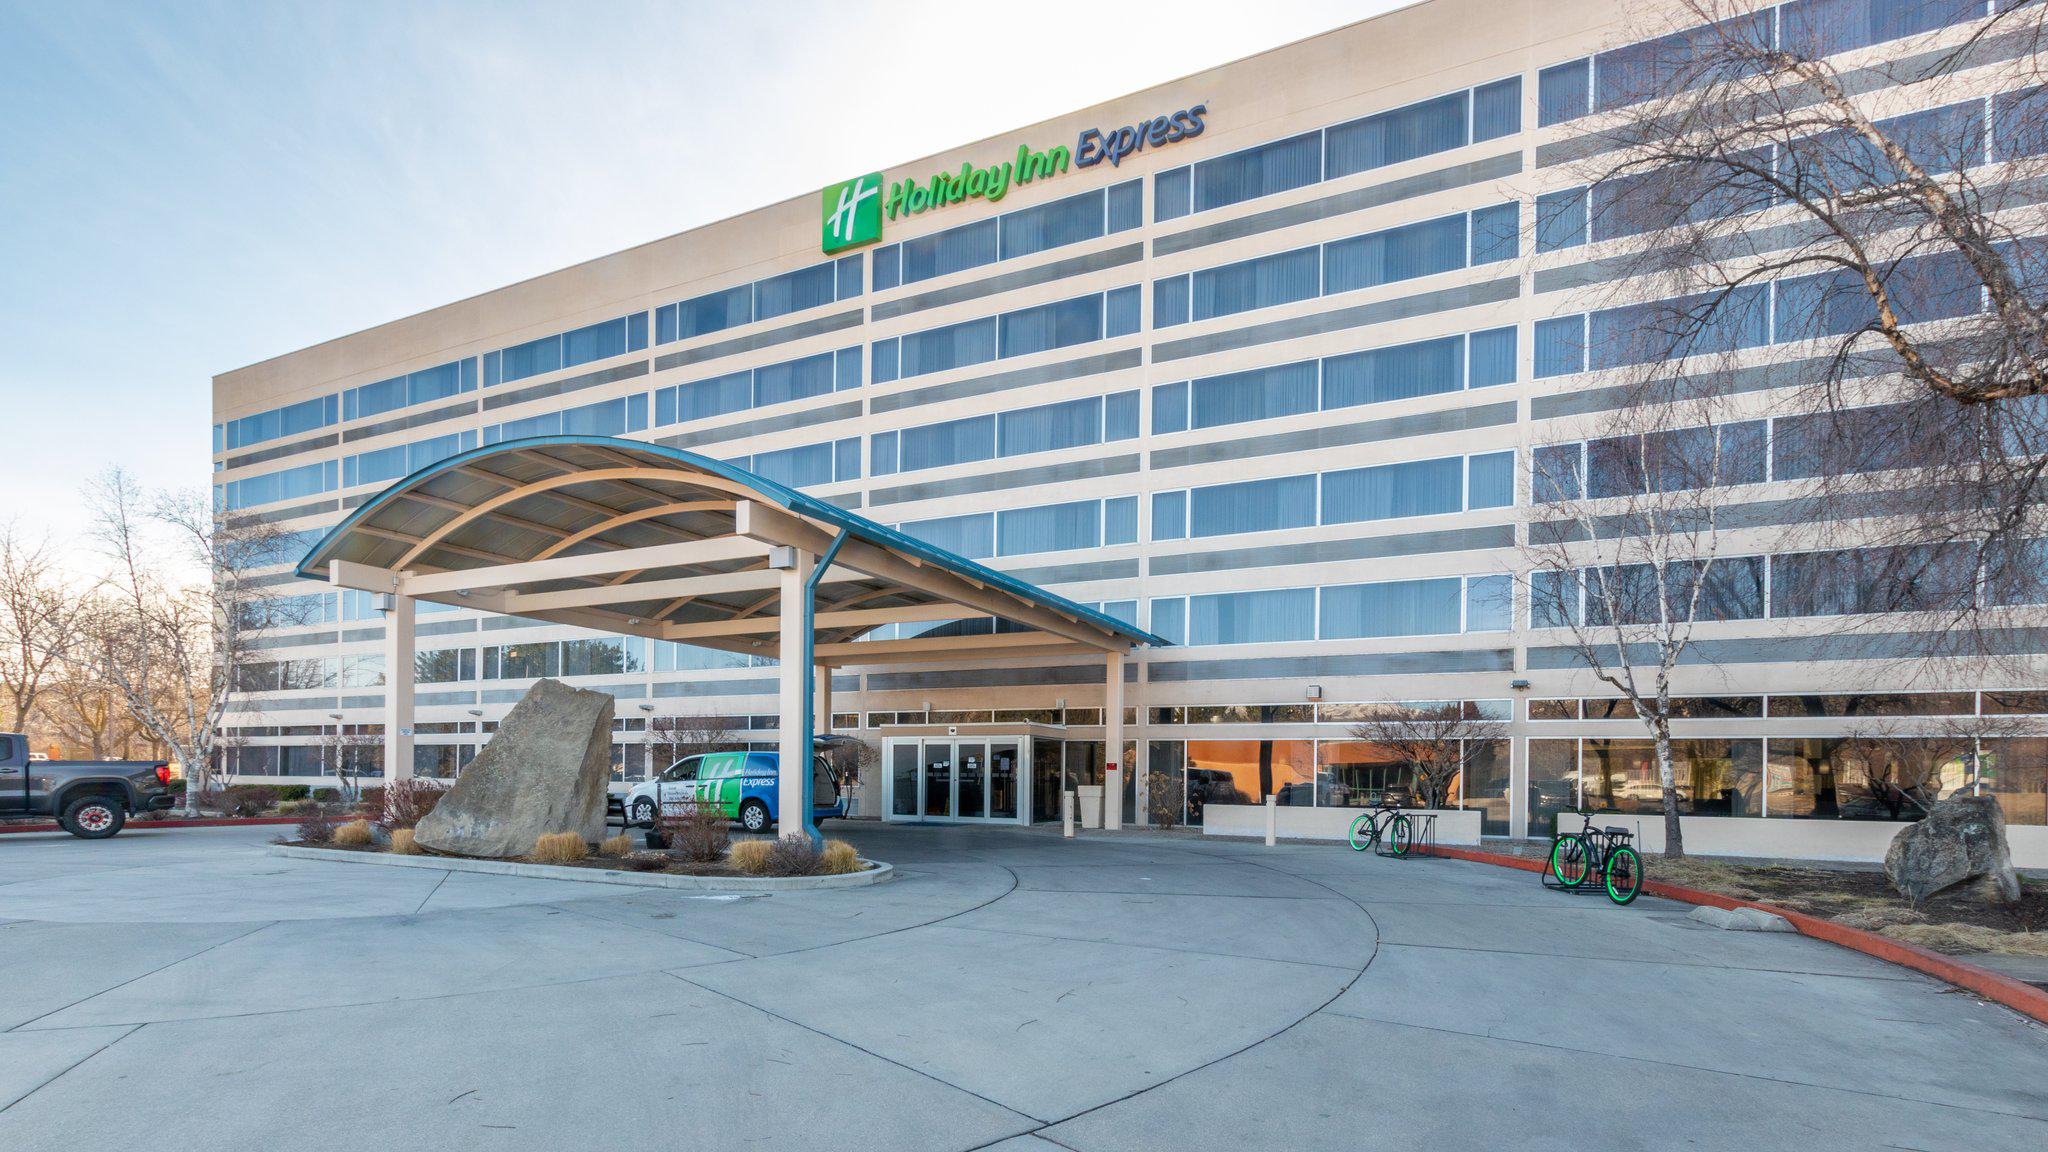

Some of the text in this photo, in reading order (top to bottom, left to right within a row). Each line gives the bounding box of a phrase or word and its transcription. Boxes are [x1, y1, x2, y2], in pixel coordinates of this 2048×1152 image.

[885, 104, 1207, 221] Holiday Inn Express
[827, 178, 878, 242] H
[743, 778, 775, 788] Express
